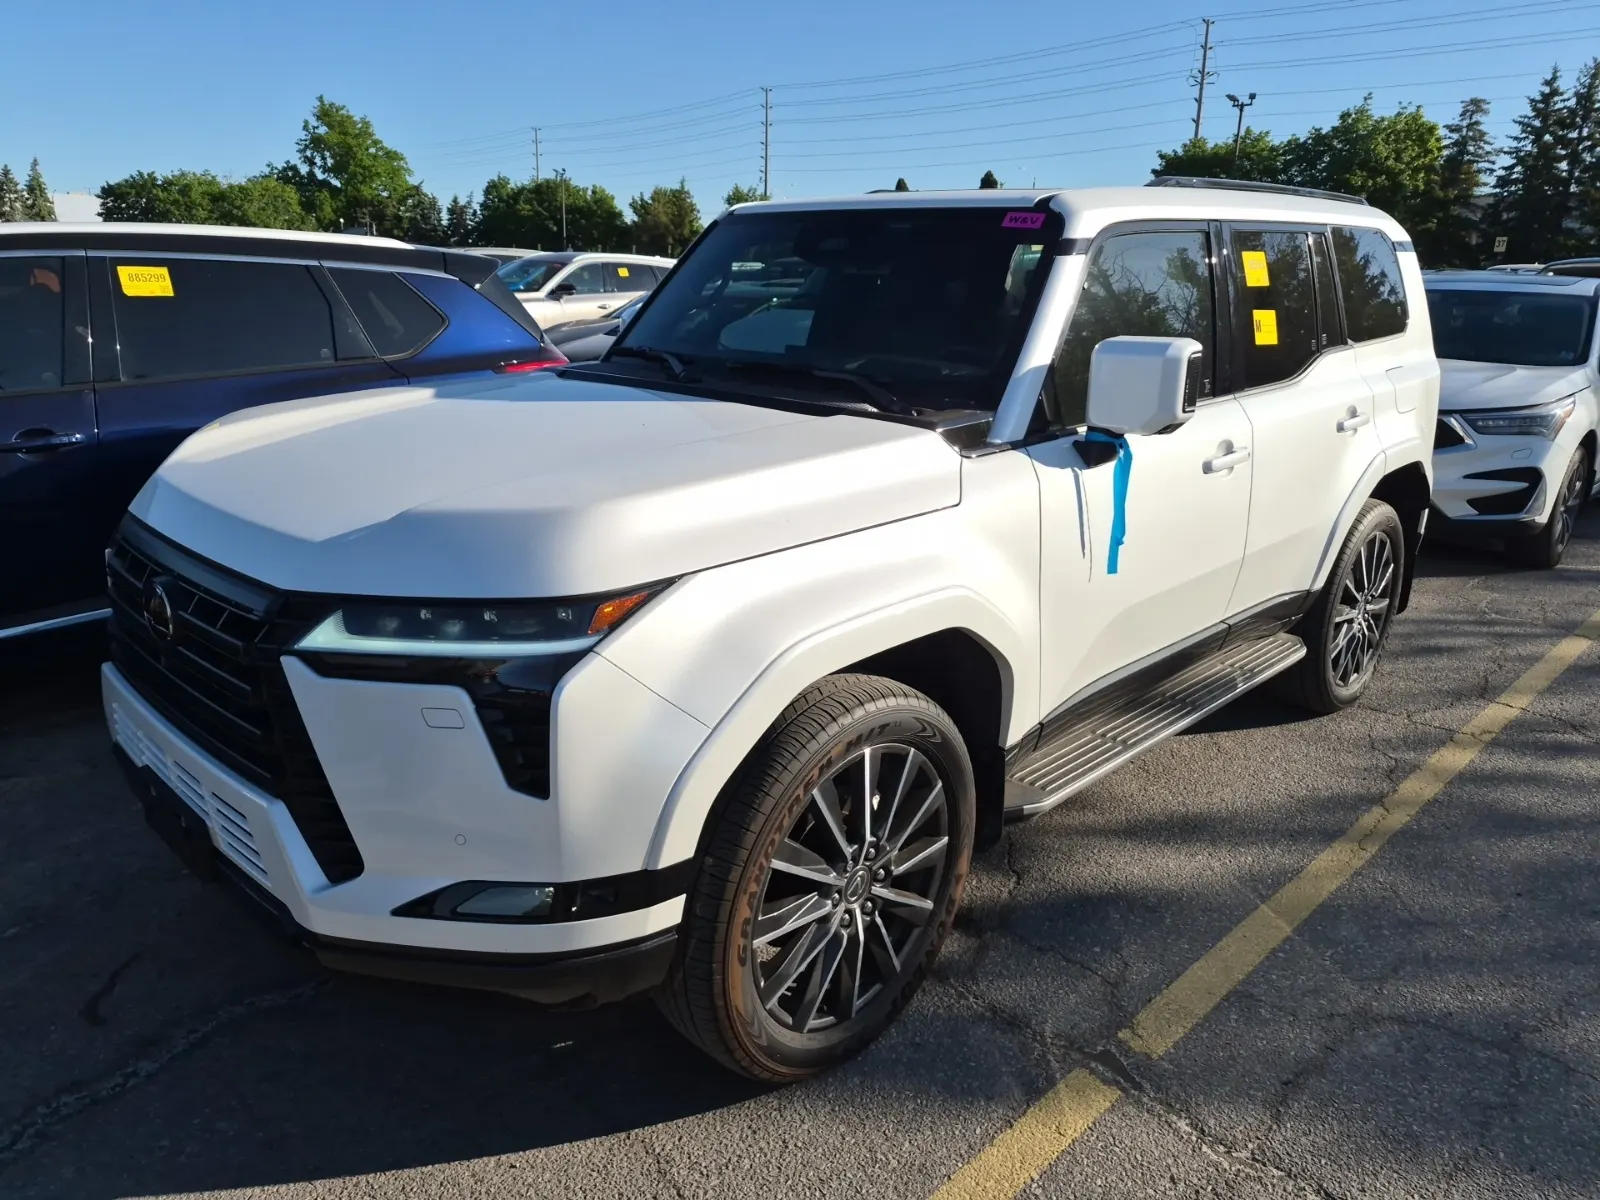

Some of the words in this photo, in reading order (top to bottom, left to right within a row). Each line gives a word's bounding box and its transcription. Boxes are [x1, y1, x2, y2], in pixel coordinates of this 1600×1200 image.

[1009, 215, 1041, 225] W&V
[1495, 239, 1506, 248] 37
[128, 273, 166, 283] 885299
